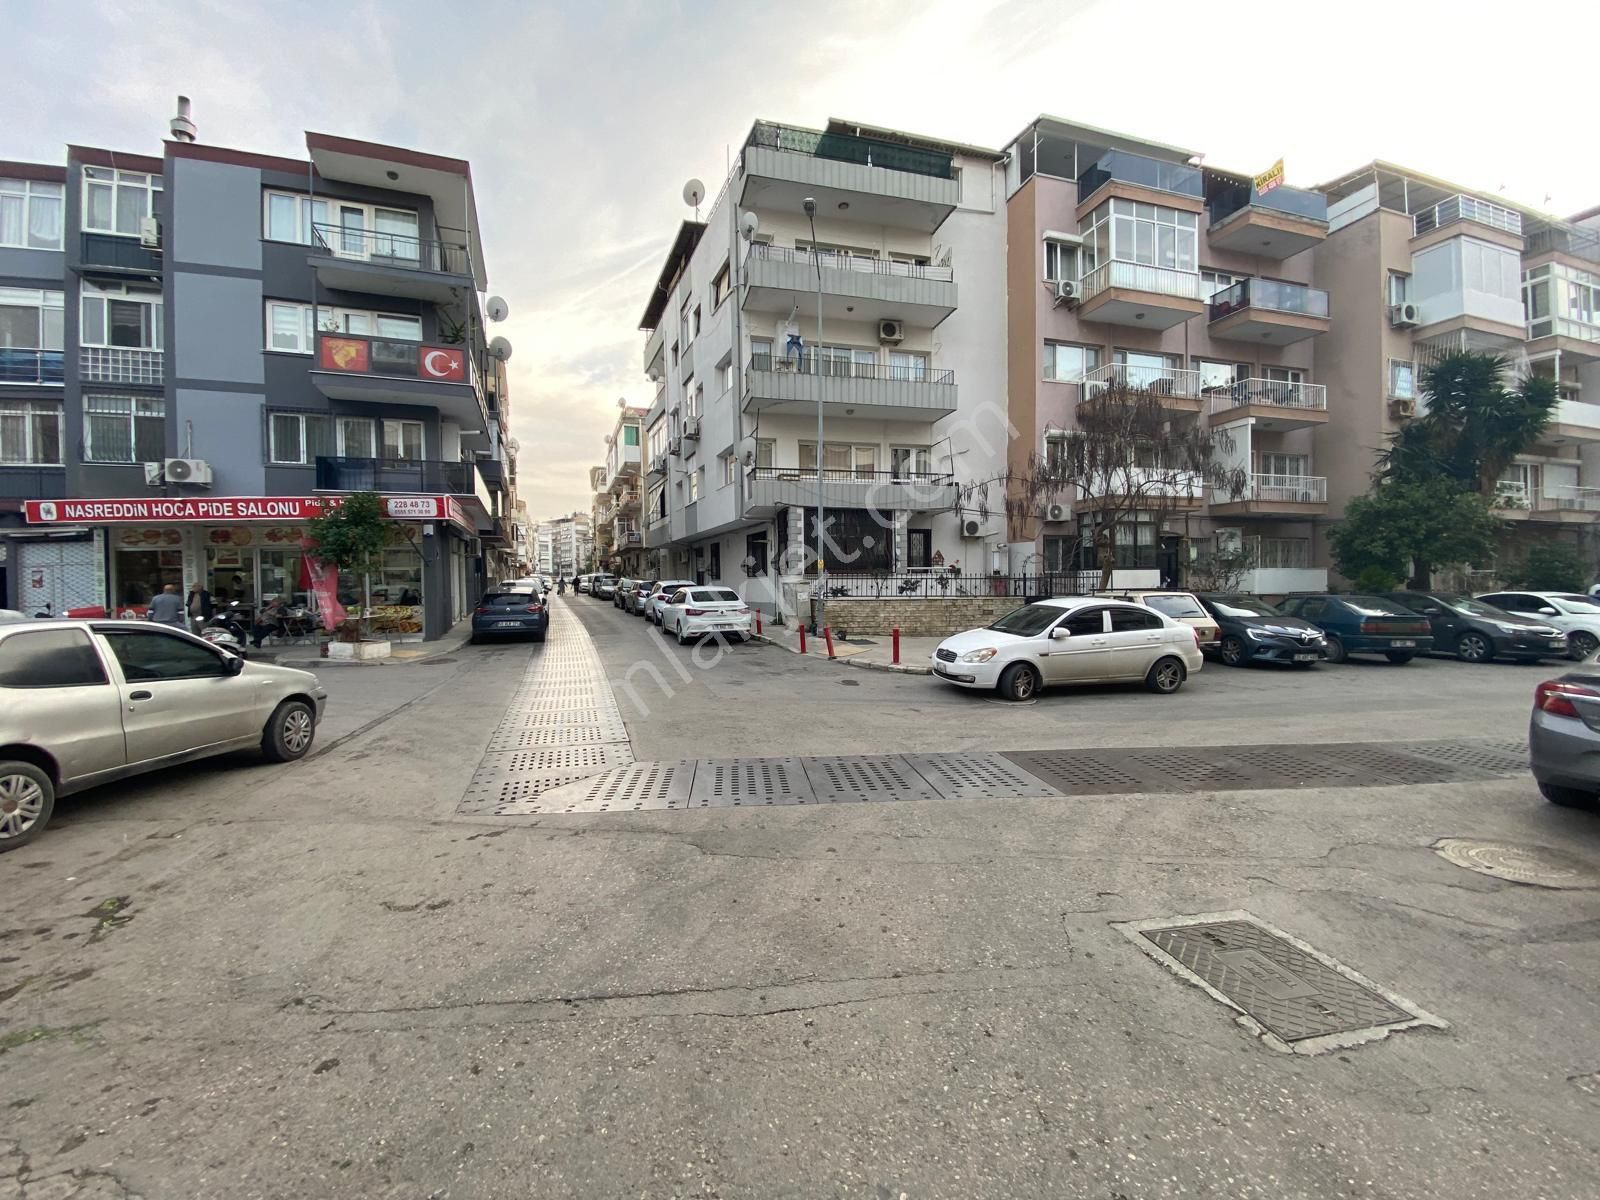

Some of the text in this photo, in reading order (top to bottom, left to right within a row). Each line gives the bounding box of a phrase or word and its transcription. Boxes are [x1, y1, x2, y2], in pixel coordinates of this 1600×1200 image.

[152, 502, 196, 517] HOCA
[237, 501, 300, 516] SALONU
[394, 500, 430, 509] 228 48 73
